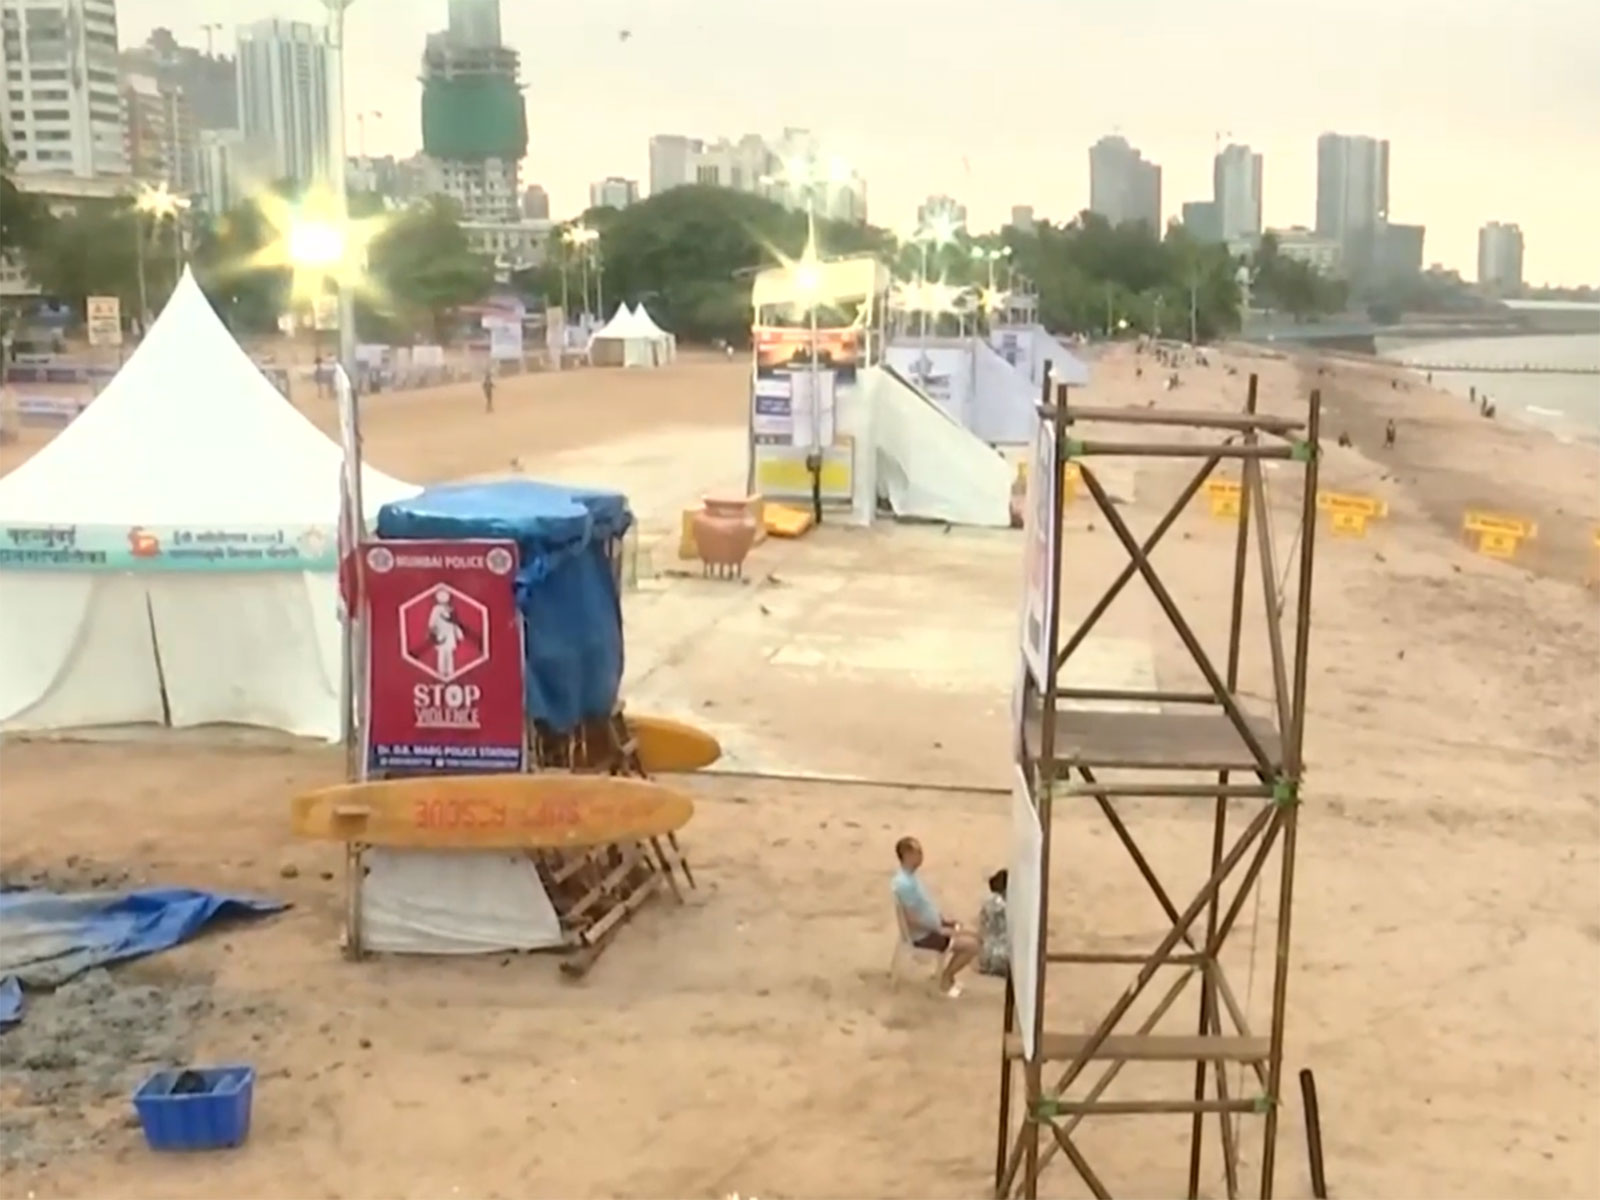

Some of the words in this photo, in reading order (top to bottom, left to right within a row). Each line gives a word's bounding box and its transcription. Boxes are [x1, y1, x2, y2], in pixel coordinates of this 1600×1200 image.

[395, 555, 442, 568] MUMBAI
[446, 555, 485, 569] POLICE
[413, 684, 481, 707] STOP
[415, 707, 480, 724] VIOLENCE
[445, 747, 477, 757] POLICE
